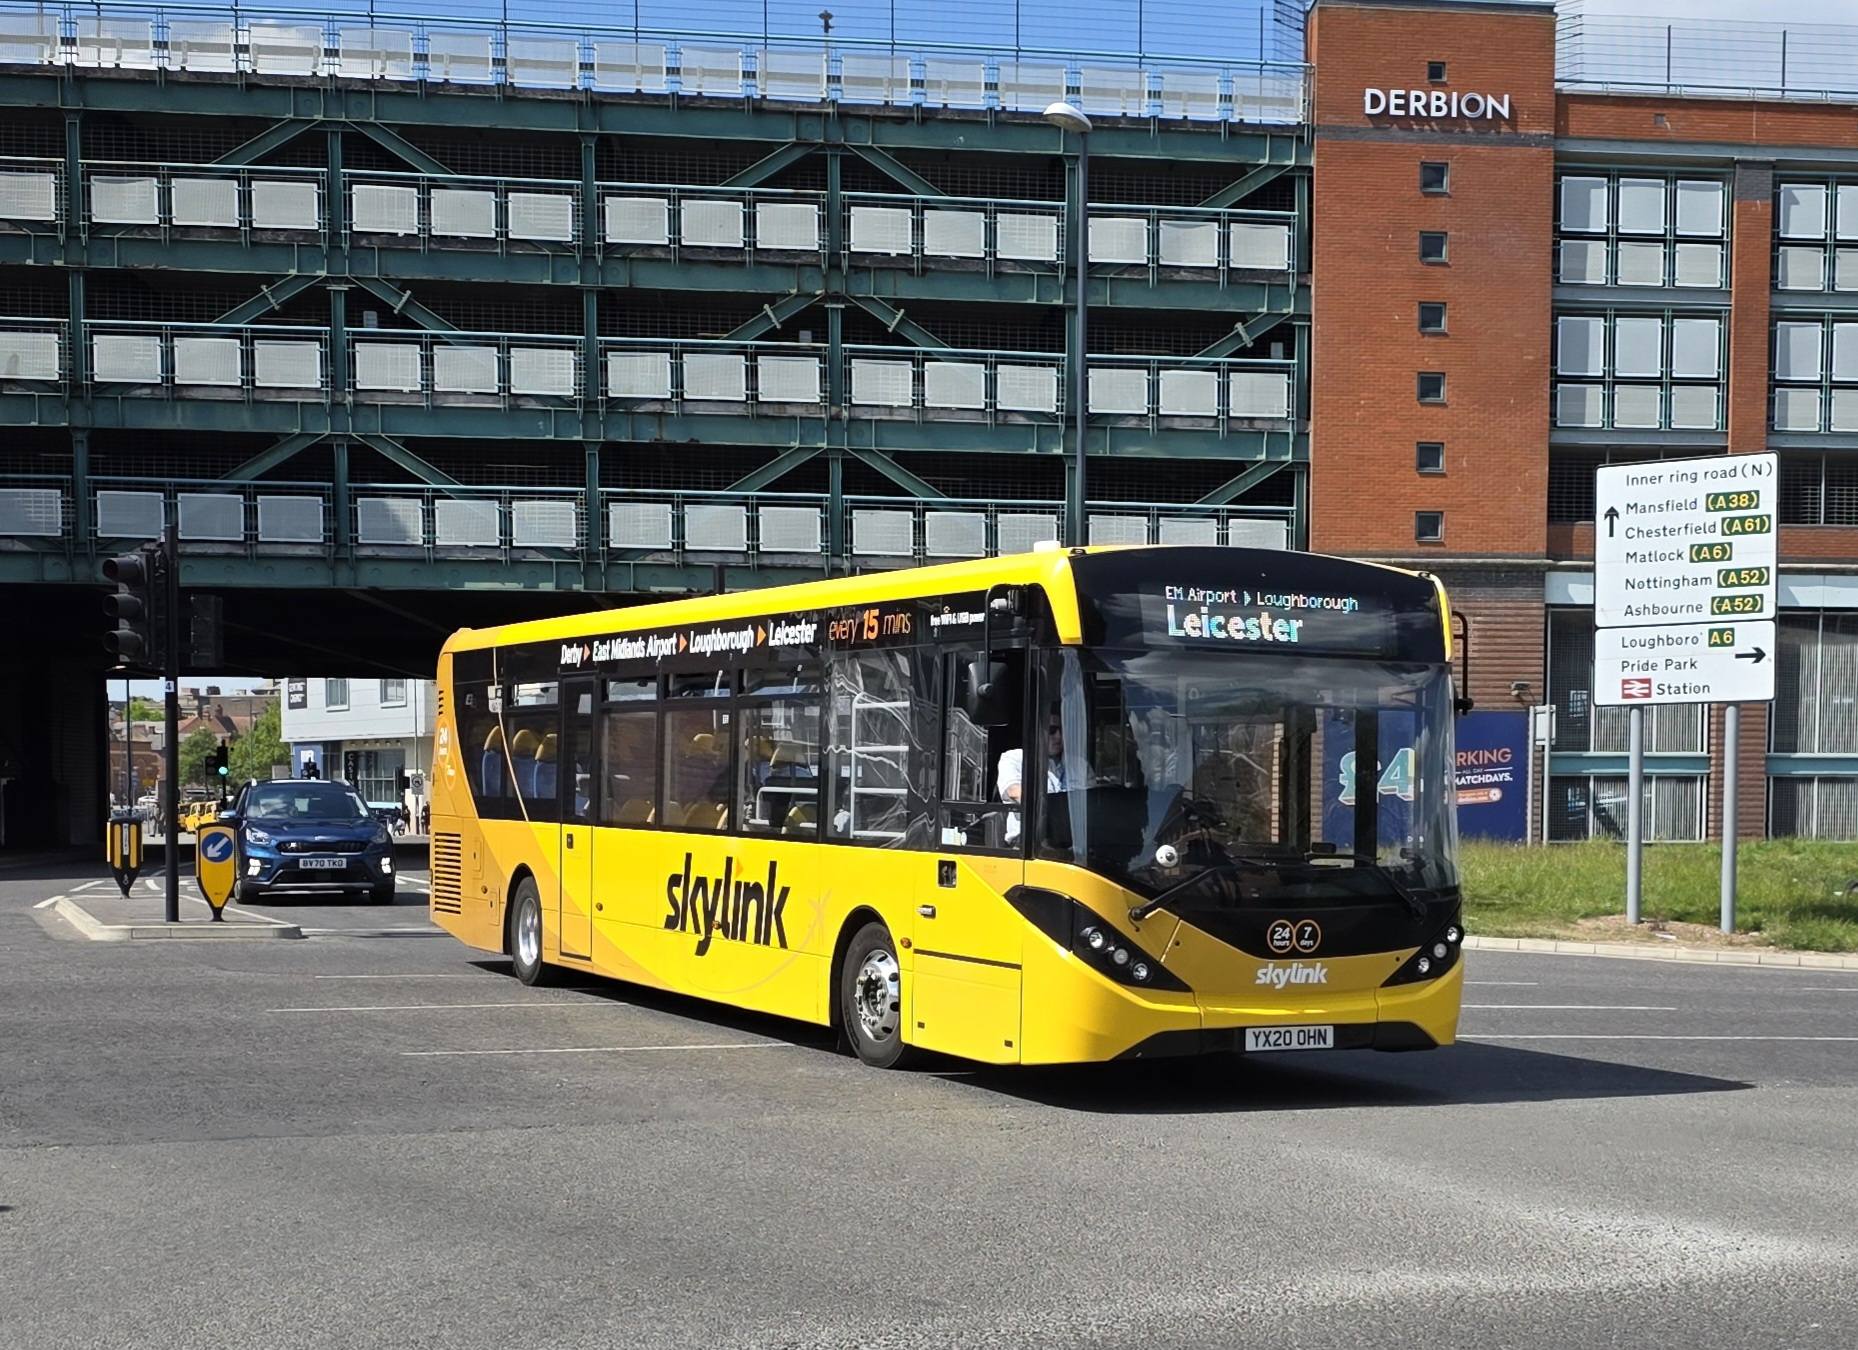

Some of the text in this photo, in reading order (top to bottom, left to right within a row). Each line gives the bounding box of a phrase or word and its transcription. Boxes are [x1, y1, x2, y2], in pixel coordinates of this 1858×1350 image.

[1364, 88, 1511, 120] DERBION
[1626, 474, 1664, 486] Inner
[1669, 471, 1698, 484] ring
[1704, 466, 1737, 480] road
[1626, 497, 1697, 515] Mansfield
[1625, 521, 1716, 540] Chesterfield
[1626, 548, 1684, 564] Matlock
[1625, 574, 1712, 591] Nottingham
[1165, 585, 1359, 614] EM Airport Loughborough
[1624, 601, 1703, 617] Ashbourne
[829, 609, 912, 645] every 15 mins
[1166, 604, 1304, 643] Leicester
[561, 620, 817, 667] Derby East Midlands Airport Loughborough Leicester
[1709, 630, 1733, 645] A6
[1621, 657, 1698, 673] Pride Park
[165, 682, 171, 690] 4
[1656, 682, 1711, 695] Station
[1456, 748, 1512, 767] RKING
[664, 852, 791, 957] skylink
[1273, 926, 1312, 939] 24 7
[1300, 939, 1314, 947] days
[1255, 962, 1329, 990] skylink
[1252, 1028, 1327, 1048] YX20 OHN
